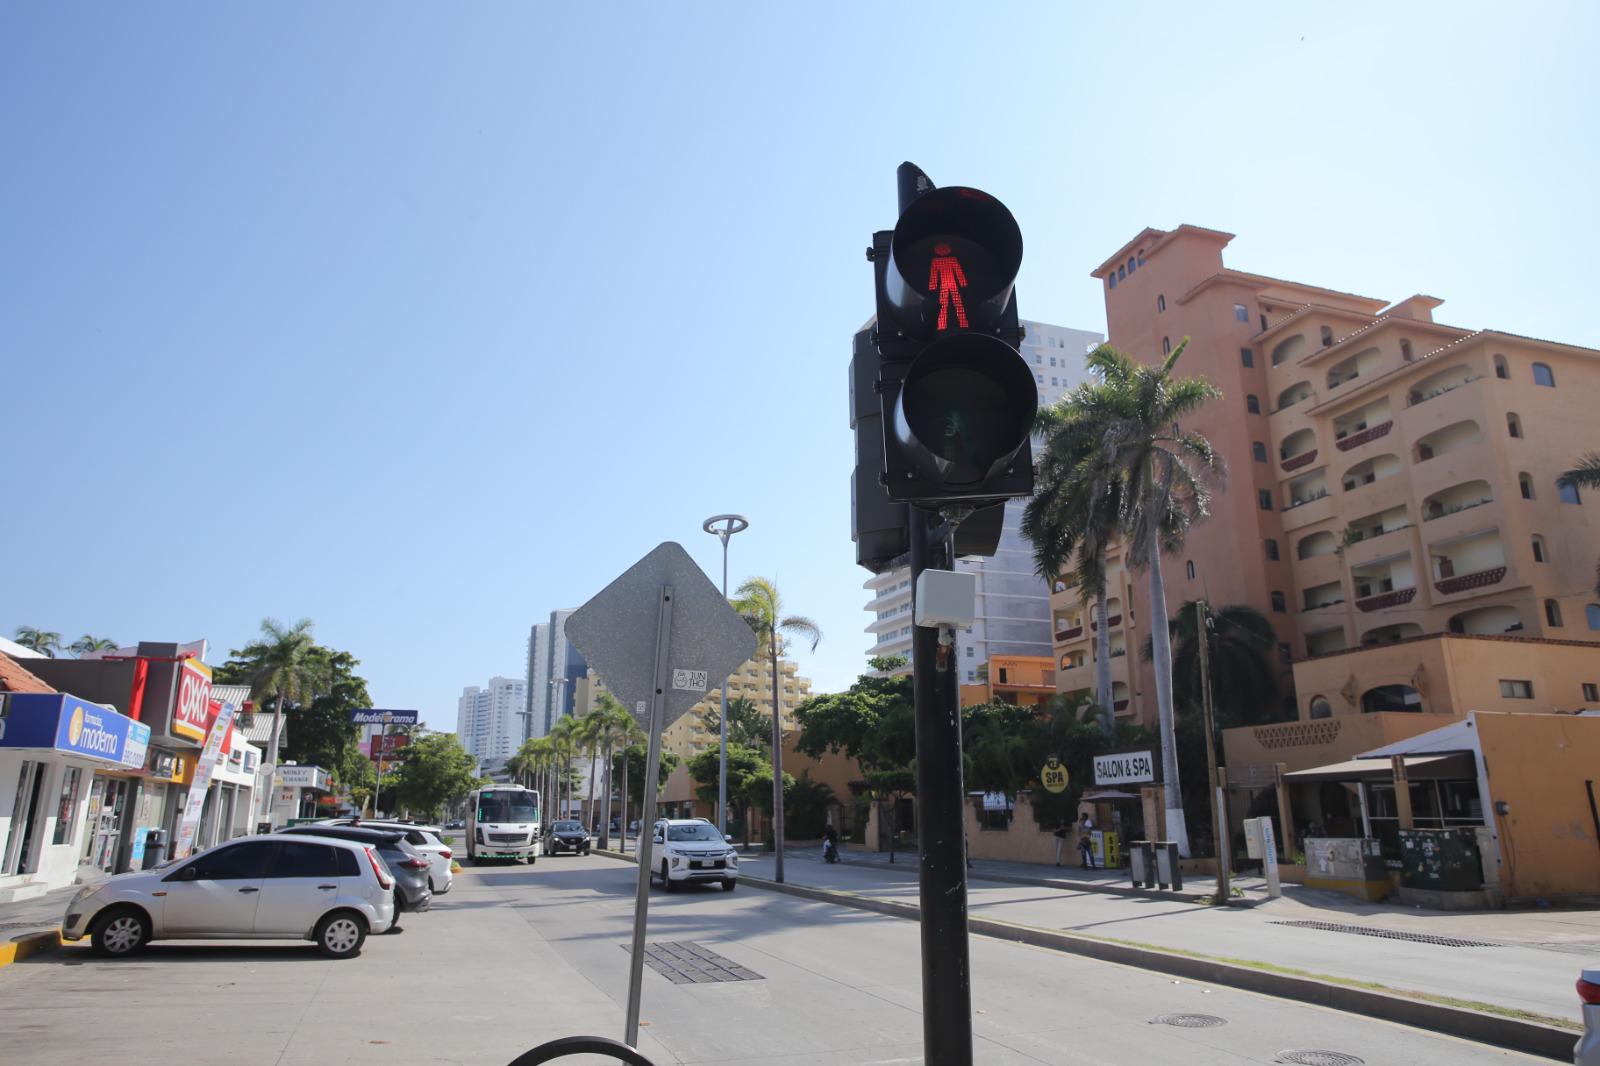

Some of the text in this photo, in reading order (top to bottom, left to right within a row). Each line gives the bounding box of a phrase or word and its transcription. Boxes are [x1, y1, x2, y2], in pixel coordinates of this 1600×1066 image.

[180, 674, 210, 723] OXXO
[80, 726, 118, 754] moderna
[1046, 771, 1064, 784] SPA
[1096, 757, 1151, 778] SALON & SPA
[1108, 836, 1116, 864] SPA
